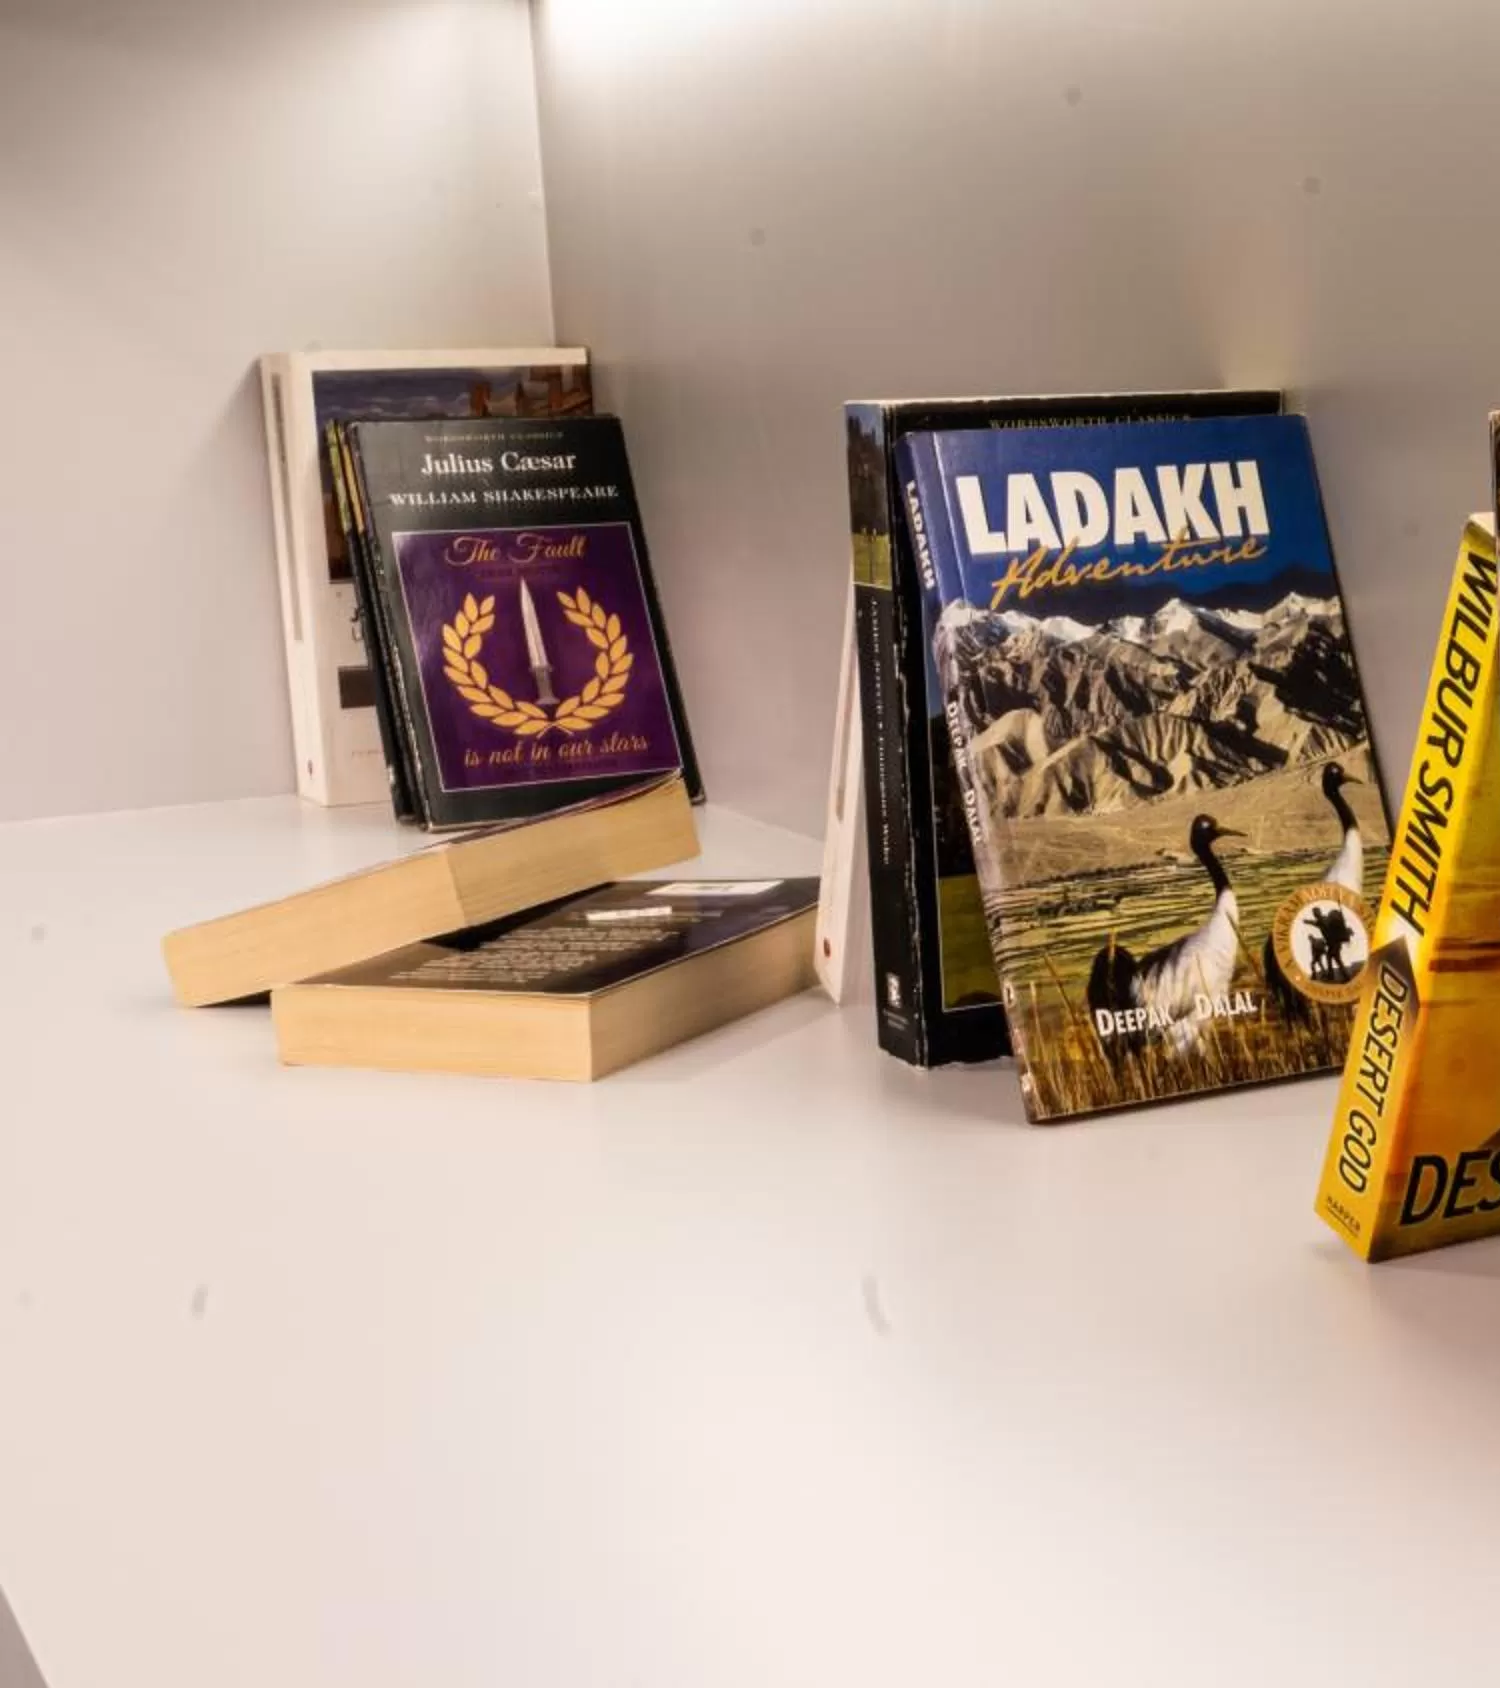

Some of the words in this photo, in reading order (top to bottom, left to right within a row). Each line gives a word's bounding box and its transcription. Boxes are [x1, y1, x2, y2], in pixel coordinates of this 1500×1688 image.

[388, 491, 476, 506] WILLIAM
[484, 485, 619, 503] SHAKESPEARE
[421, 453, 493, 475] Julius
[445, 535, 498, 566] The
[508, 533, 587, 563] Fault
[906, 480, 936, 590] LADAKH
[956, 459, 1270, 556] LADAKH
[990, 526, 1269, 611] Adventure
[1426, 551, 1498, 770] WILBUR
[464, 747, 480, 768] is
[489, 740, 523, 766] not
[530, 741, 549, 761] in
[558, 737, 593, 759] our
[600, 731, 648, 753] stars
[1390, 759, 1454, 937] SMITH
[1095, 1007, 1175, 1037] DEEPAK
[1194, 991, 1258, 1020] DALAL
[1355, 963, 1409, 1117] DESERT
[1339, 1109, 1378, 1194] GOD
